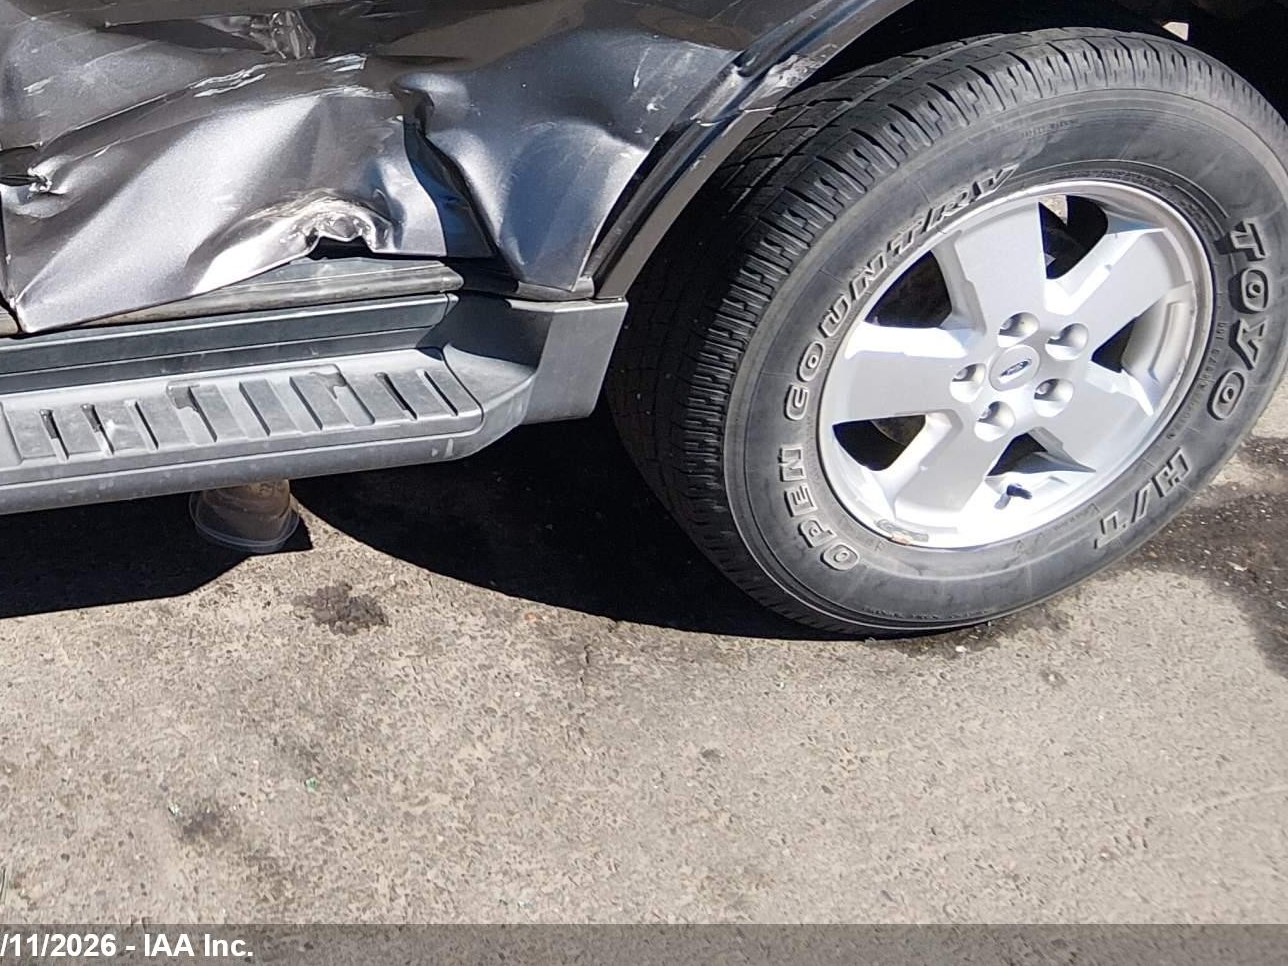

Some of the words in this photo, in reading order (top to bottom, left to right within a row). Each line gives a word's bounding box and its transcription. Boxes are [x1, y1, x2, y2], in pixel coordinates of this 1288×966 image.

[784, 163, 1021, 421] COUNTRY
[1208, 217, 1270, 421] TOYO
[778, 444, 861, 571] OPEN
[1094, 446, 1192, 549] H/T
